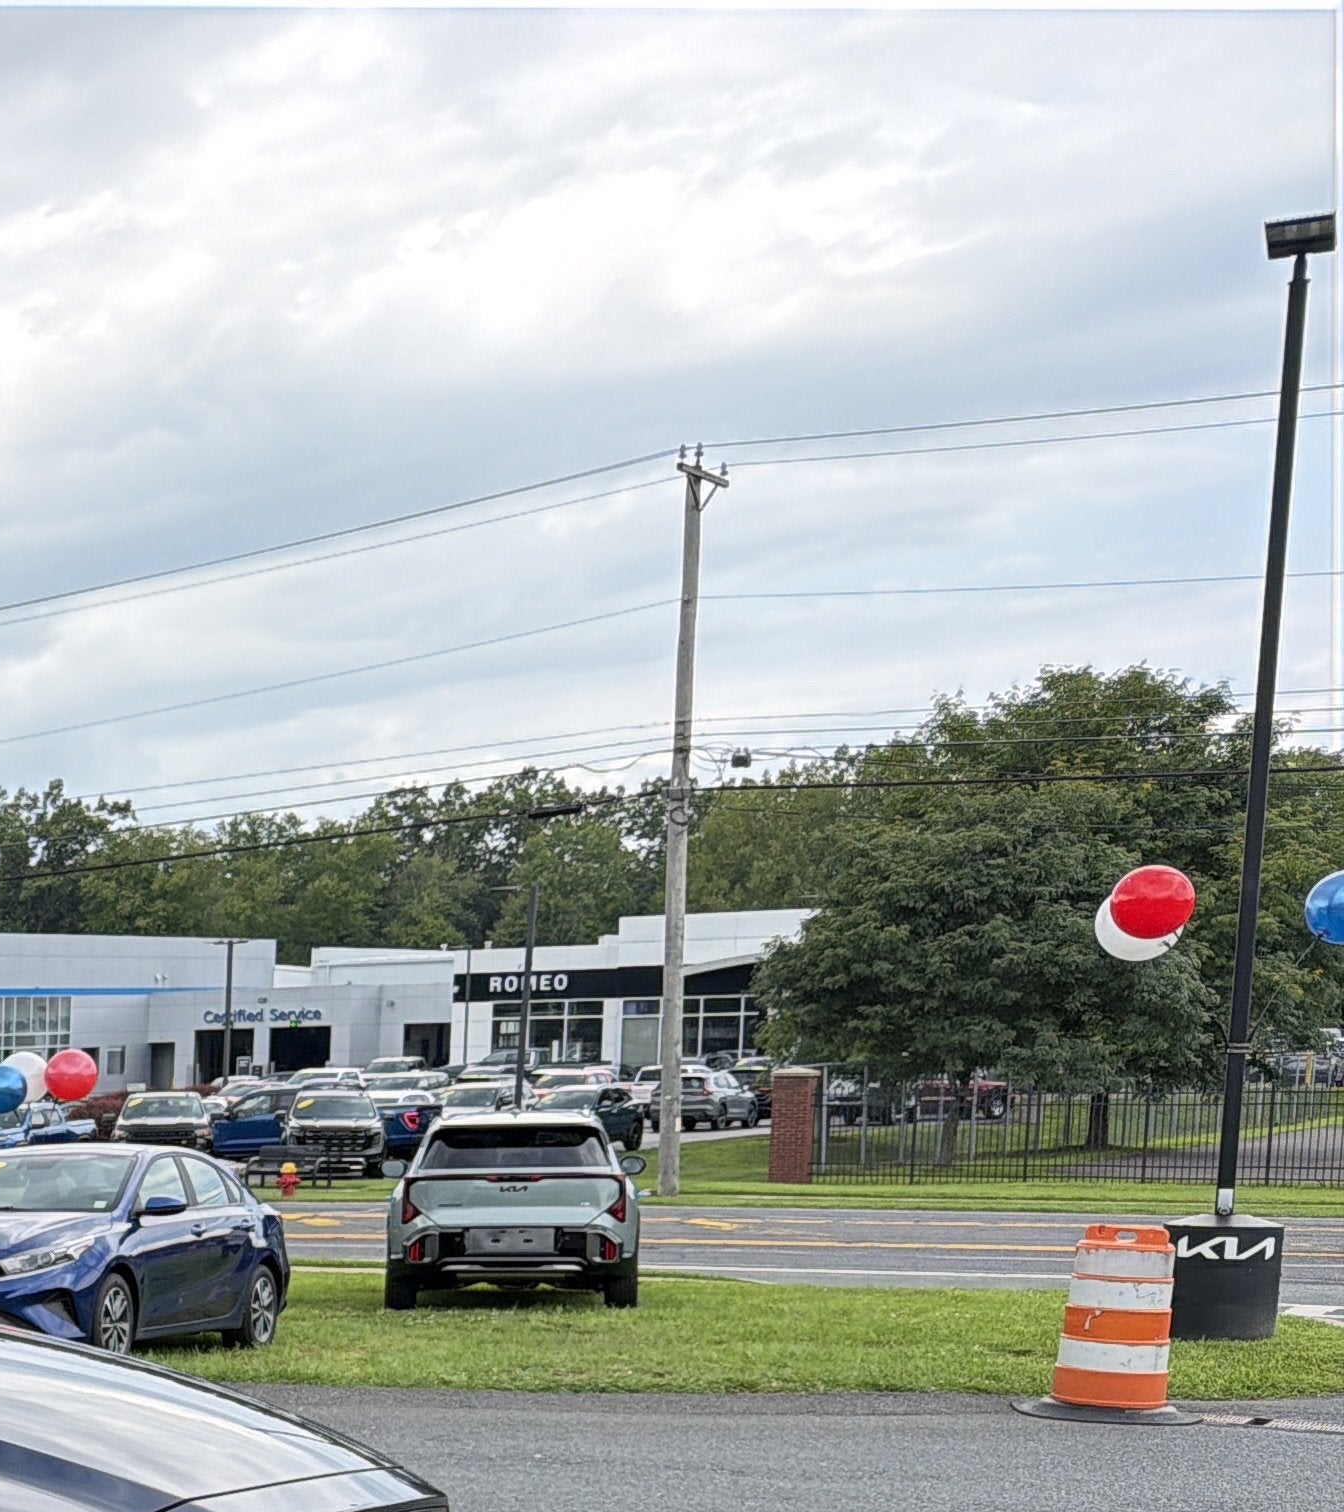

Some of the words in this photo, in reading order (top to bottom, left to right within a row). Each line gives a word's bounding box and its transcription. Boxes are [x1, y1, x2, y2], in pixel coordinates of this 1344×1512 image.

[488, 973, 569, 993] ROMEO
[203, 1008, 264, 1024] Cerified
[269, 1007, 322, 1022] Service
[1177, 1235, 1276, 1260] KIA
